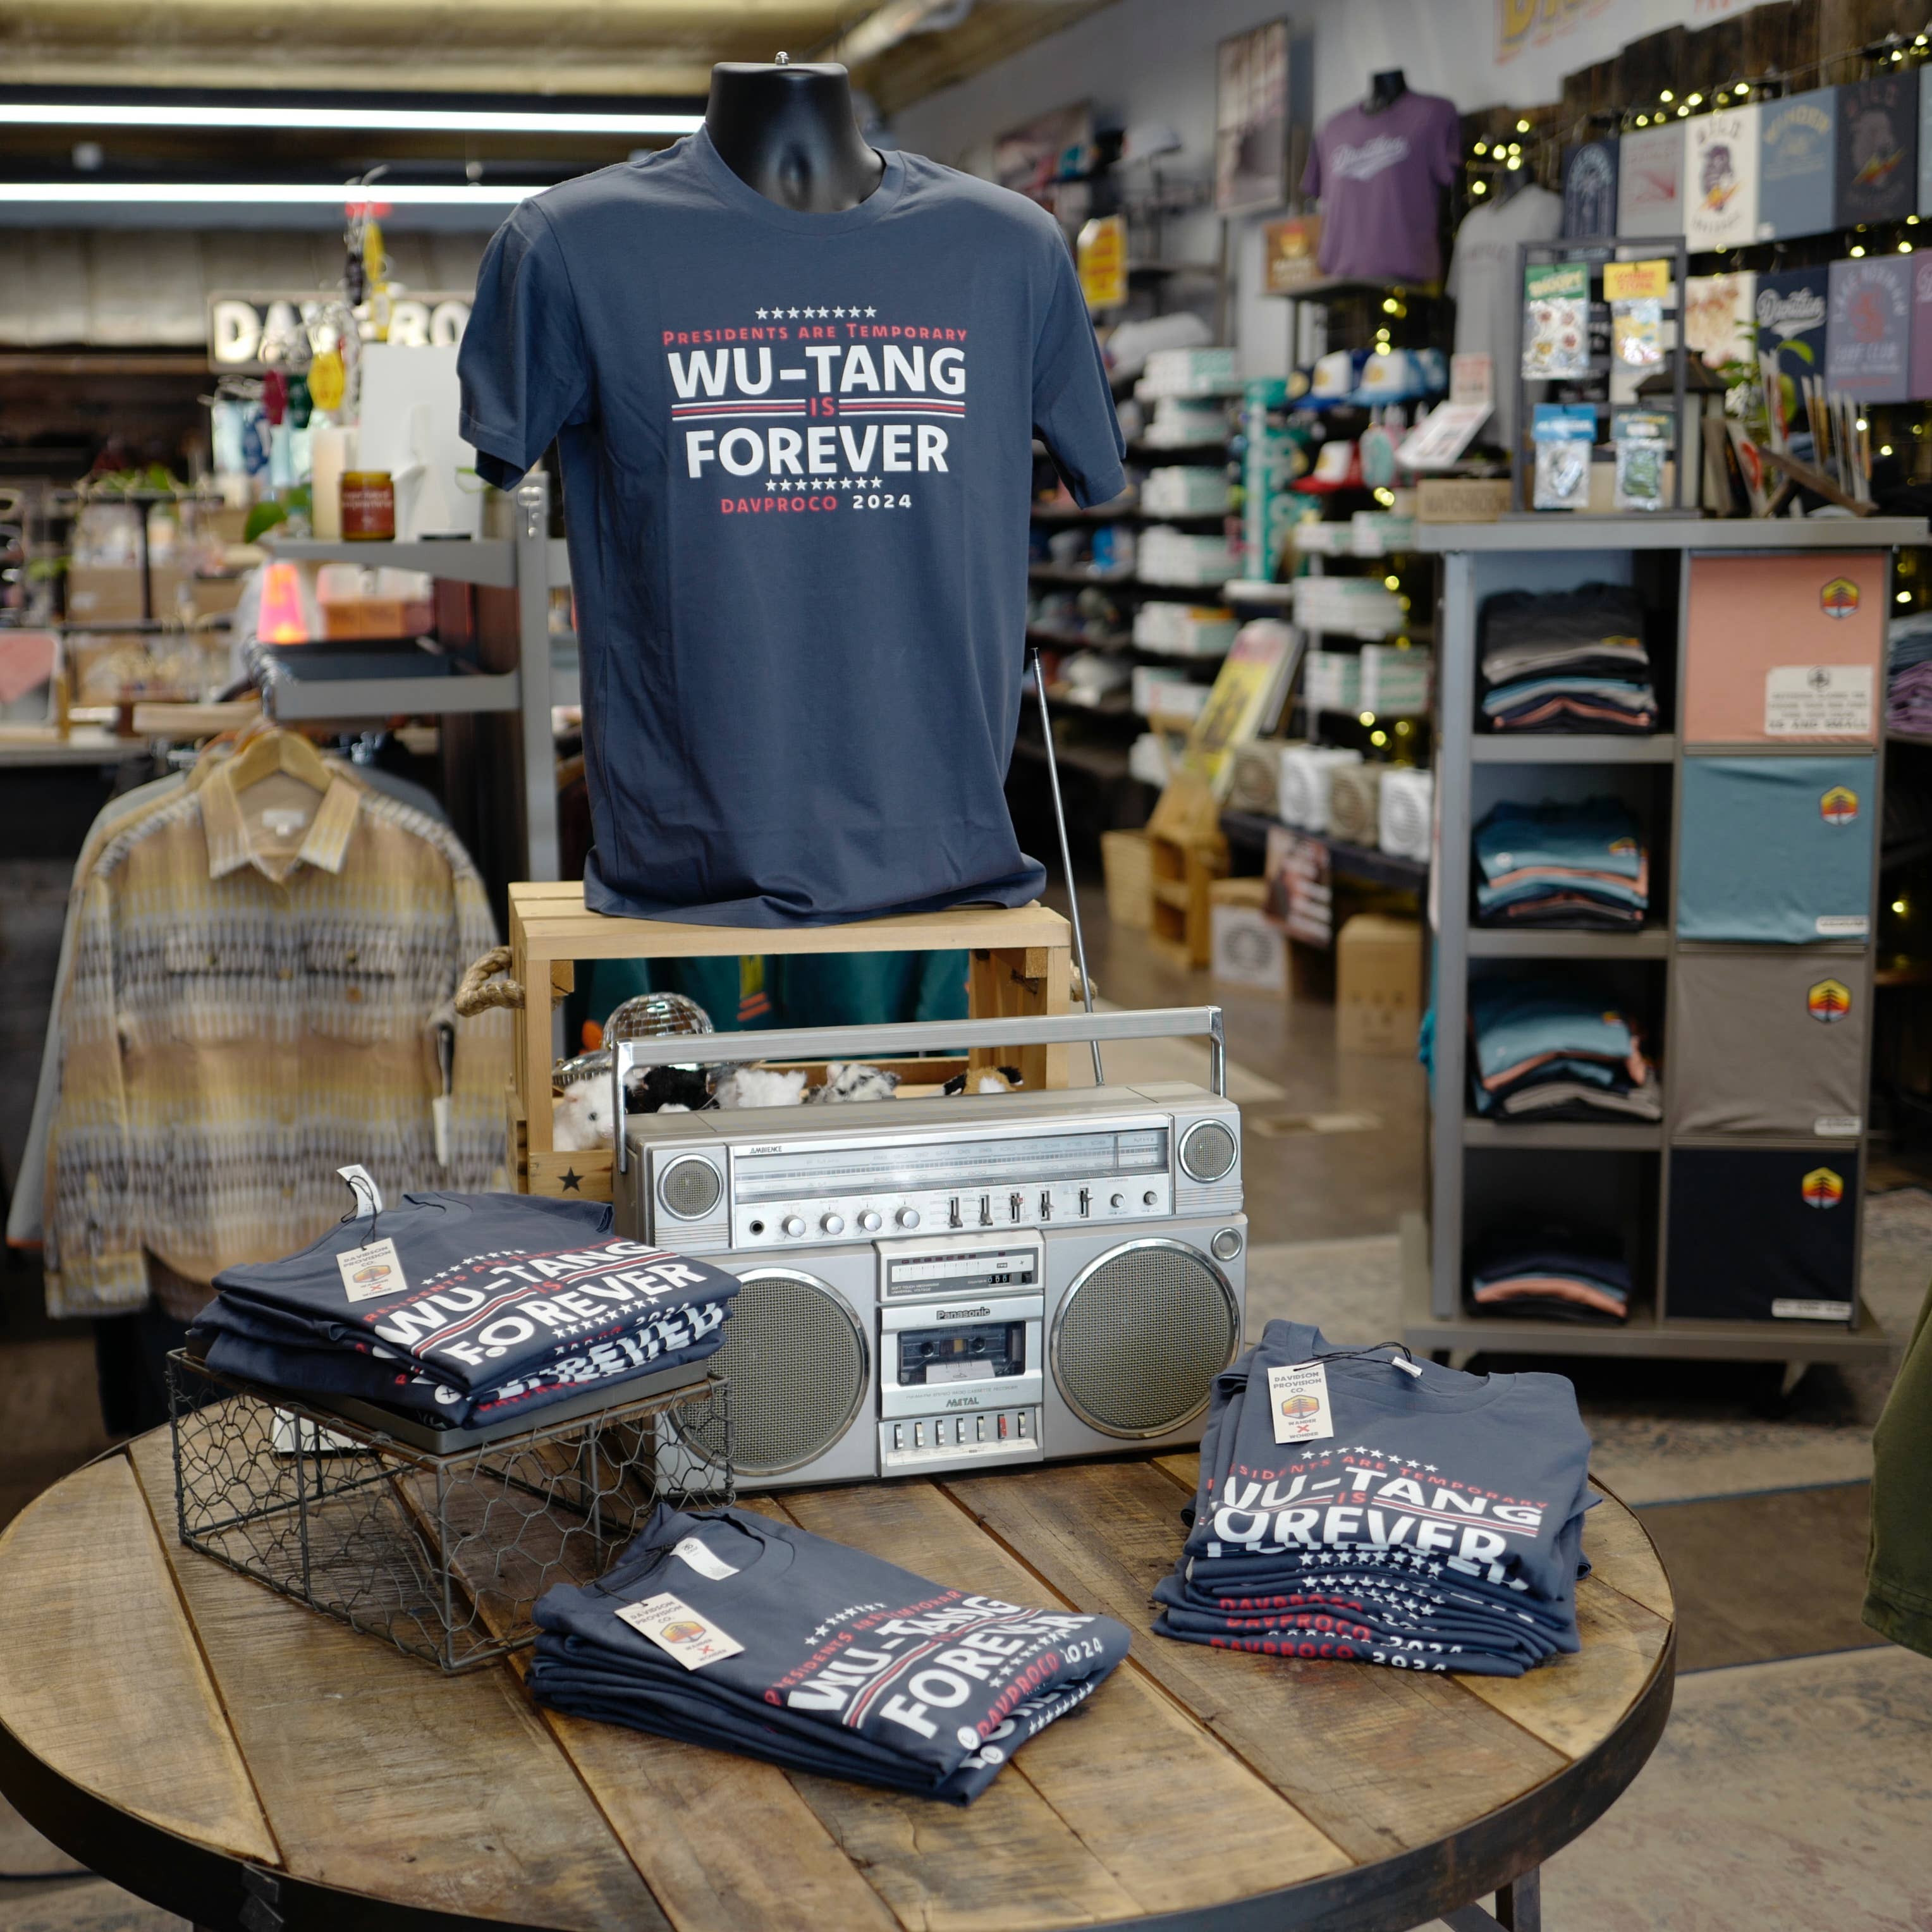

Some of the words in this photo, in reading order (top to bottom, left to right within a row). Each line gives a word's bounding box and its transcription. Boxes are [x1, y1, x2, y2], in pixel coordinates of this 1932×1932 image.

[798, 324, 836, 339] ARE
[667, 345, 966, 398] WU-TANG
[810, 396, 835, 417] IS
[686, 425, 949, 478] FOREVER
[721, 496, 838, 514] DAVPROCO
[853, 494, 912, 509] 2024
[343, 1250, 391, 1268] PROVISION
[344, 1246, 388, 1263] DAVIDSON
[374, 1242, 662, 1346] WU-TANG
[532, 1281, 563, 1294] IS
[442, 1264, 708, 1366] FOREVER
[936, 1307, 991, 1320] Panasonic
[1273, 1378, 1322, 1389] PROVISION
[1275, 1372, 1319, 1382] DAVIDSON
[946, 1397, 979, 1408] METAL
[1342, 1455, 1386, 1470] ARE
[1399, 1467, 1548, 1508] TEMPORARY
[1337, 1492, 1366, 1505] IS
[1213, 1506, 1507, 1567] OREVER
[630, 1601, 676, 1620] DAVIDSON
[635, 1605, 683, 1625] PROVISION
[787, 1596, 1023, 1711] WU-TANG
